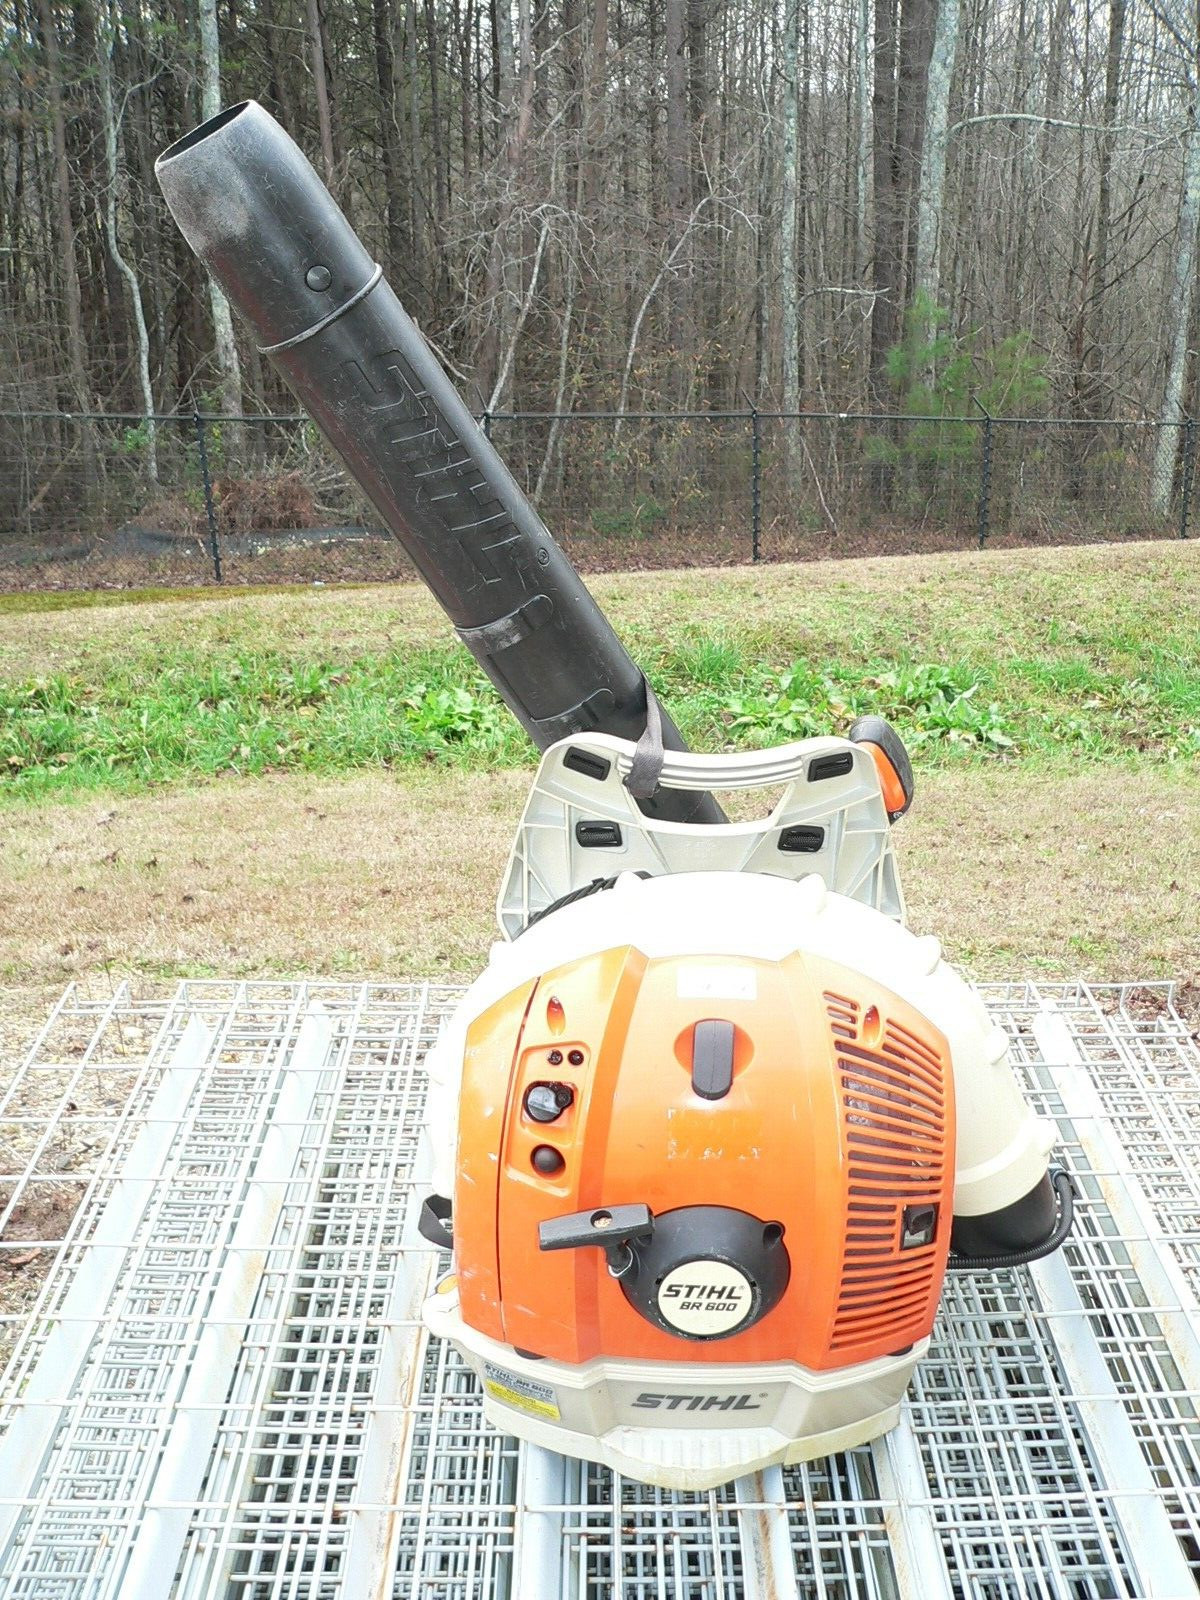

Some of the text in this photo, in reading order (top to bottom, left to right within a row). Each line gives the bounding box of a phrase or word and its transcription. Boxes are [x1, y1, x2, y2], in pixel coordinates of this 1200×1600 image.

[338, 349, 522, 585] STIHL
[662, 1284, 742, 1300] STIHL
[679, 1301, 738, 1312] BR 600
[631, 1393, 760, 1411] STIHL
